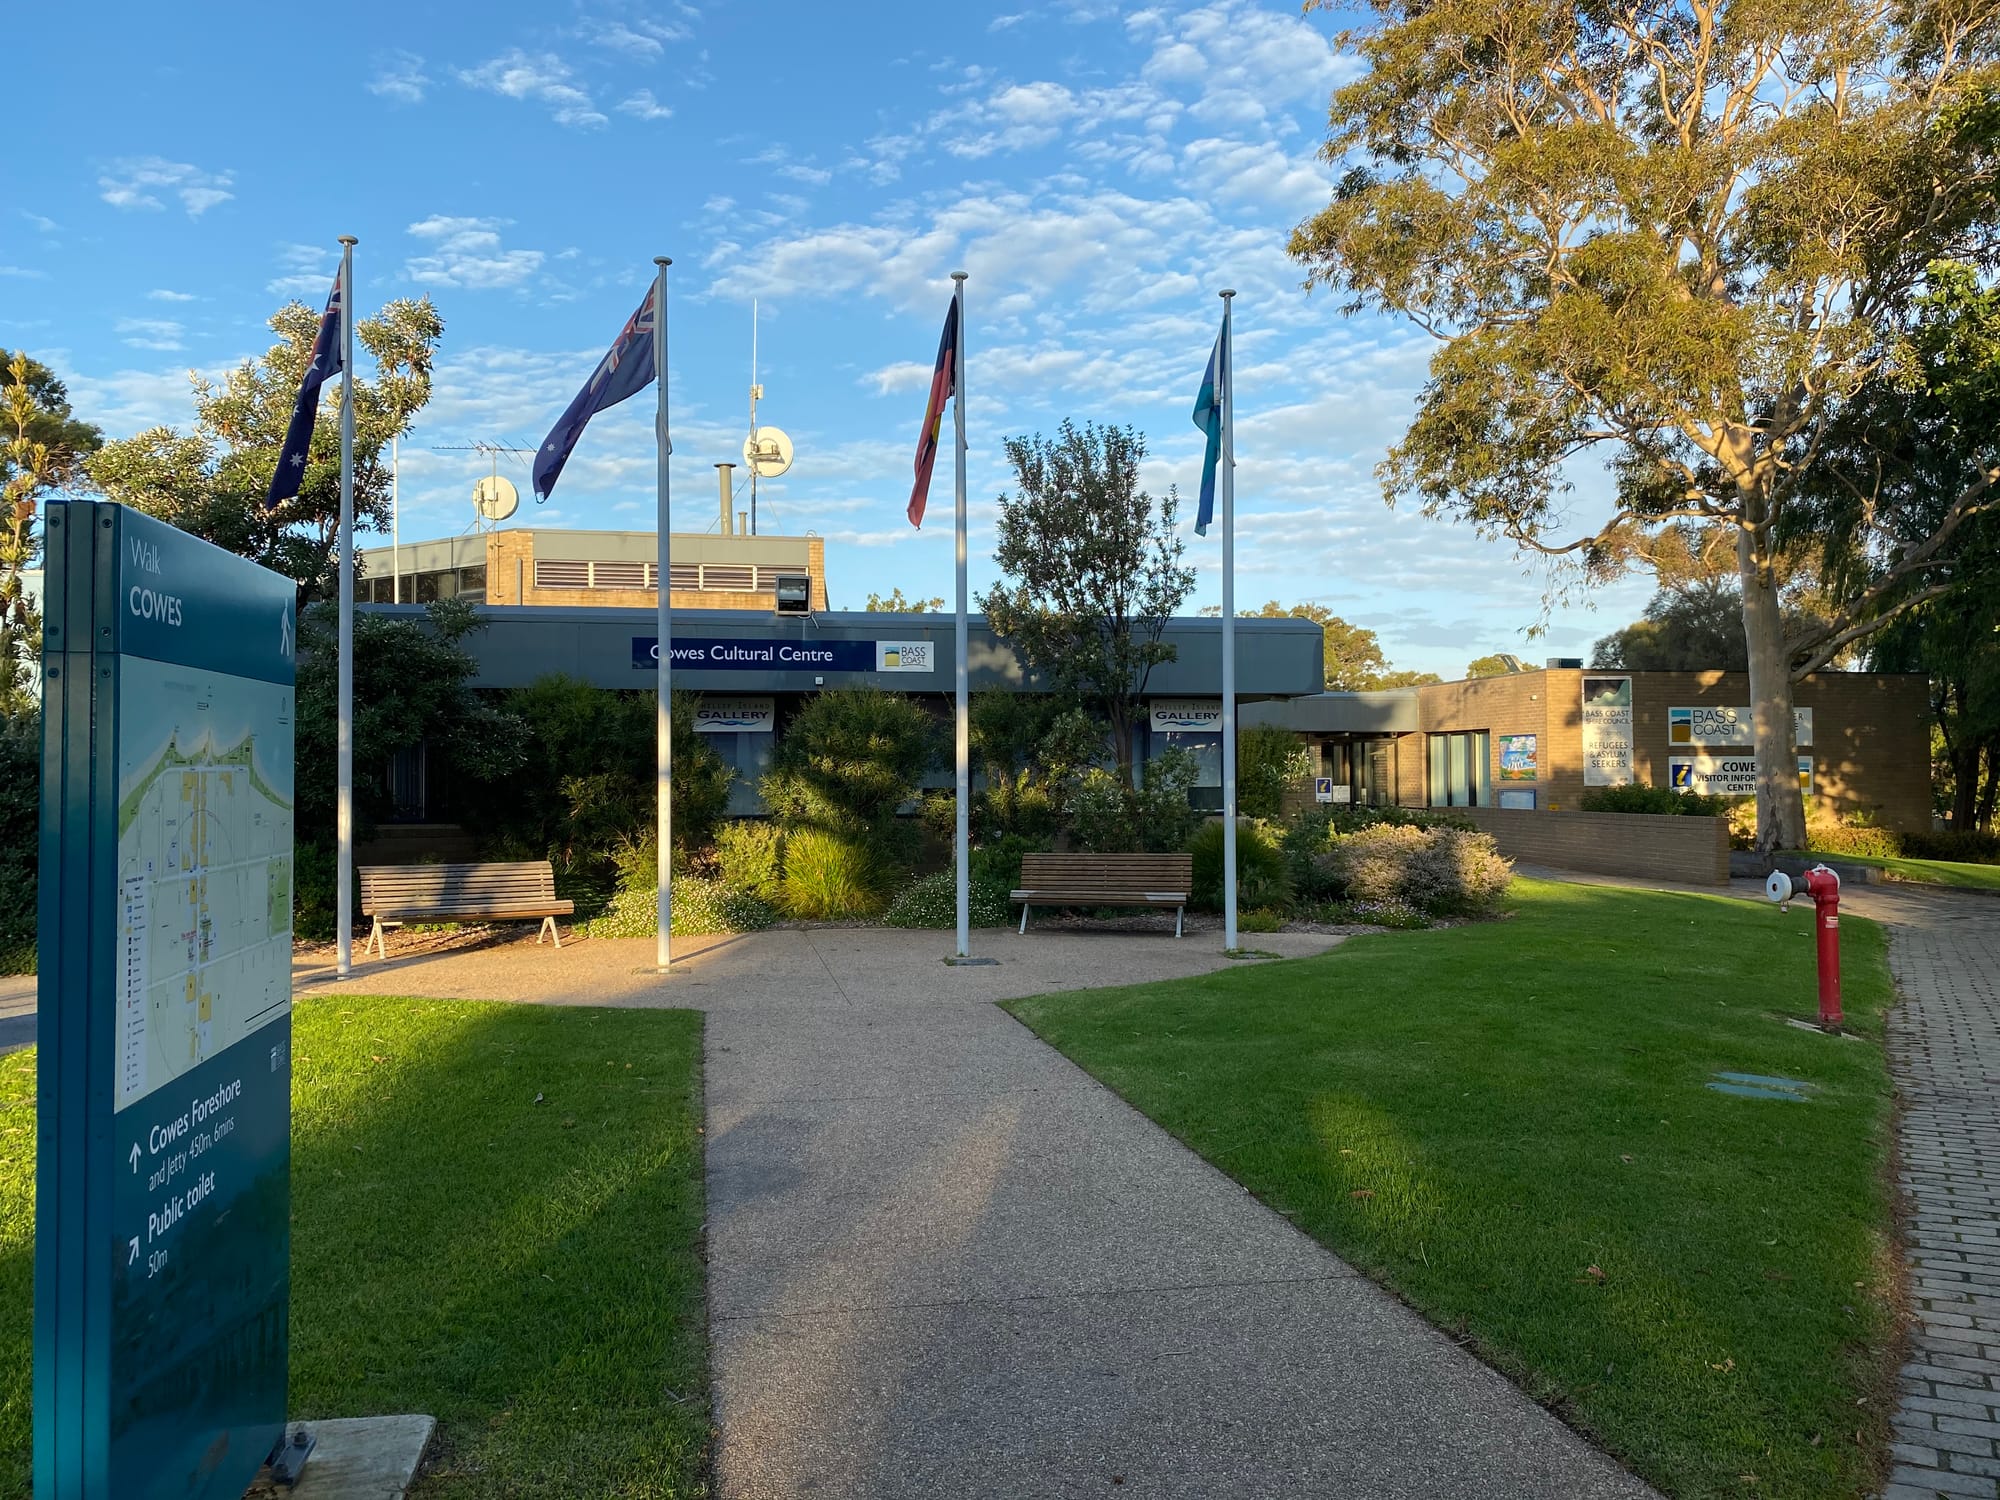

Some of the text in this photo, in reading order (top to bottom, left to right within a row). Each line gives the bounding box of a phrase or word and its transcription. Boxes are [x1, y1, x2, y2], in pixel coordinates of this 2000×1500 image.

[130, 536, 161, 575] Walk
[129, 586, 182, 627] COWES
[710, 645, 773, 661] Cultural
[779, 646, 833, 662] Centre
[901, 646, 926, 657] BASS
[901, 656, 926, 664] COAST
[697, 710, 769, 719] GALLERY
[1155, 711, 1220, 720] GALLERY
[1585, 710, 1630, 718] BASS COAST
[1692, 710, 1737, 724] BASS
[1693, 724, 1737, 735] COAST
[1589, 741, 1629, 750] REFUGEES
[1589, 750, 1627, 759] & ASYLUM
[1591, 759, 1627, 768] SEEKERS
[1722, 762, 1756, 772] COWE
[1696, 774, 1729, 782] VISITOR
[1727, 783, 1757, 791] CENTR
[149, 1079, 241, 1155] Cowes Foreshore
[149, 1160, 165, 1192] and
[166, 1150, 187, 1185] Jetty
[214, 1116, 235, 1143] 6mins
[148, 1170, 216, 1244] Public toilet
[148, 1249, 168, 1279] 50m
